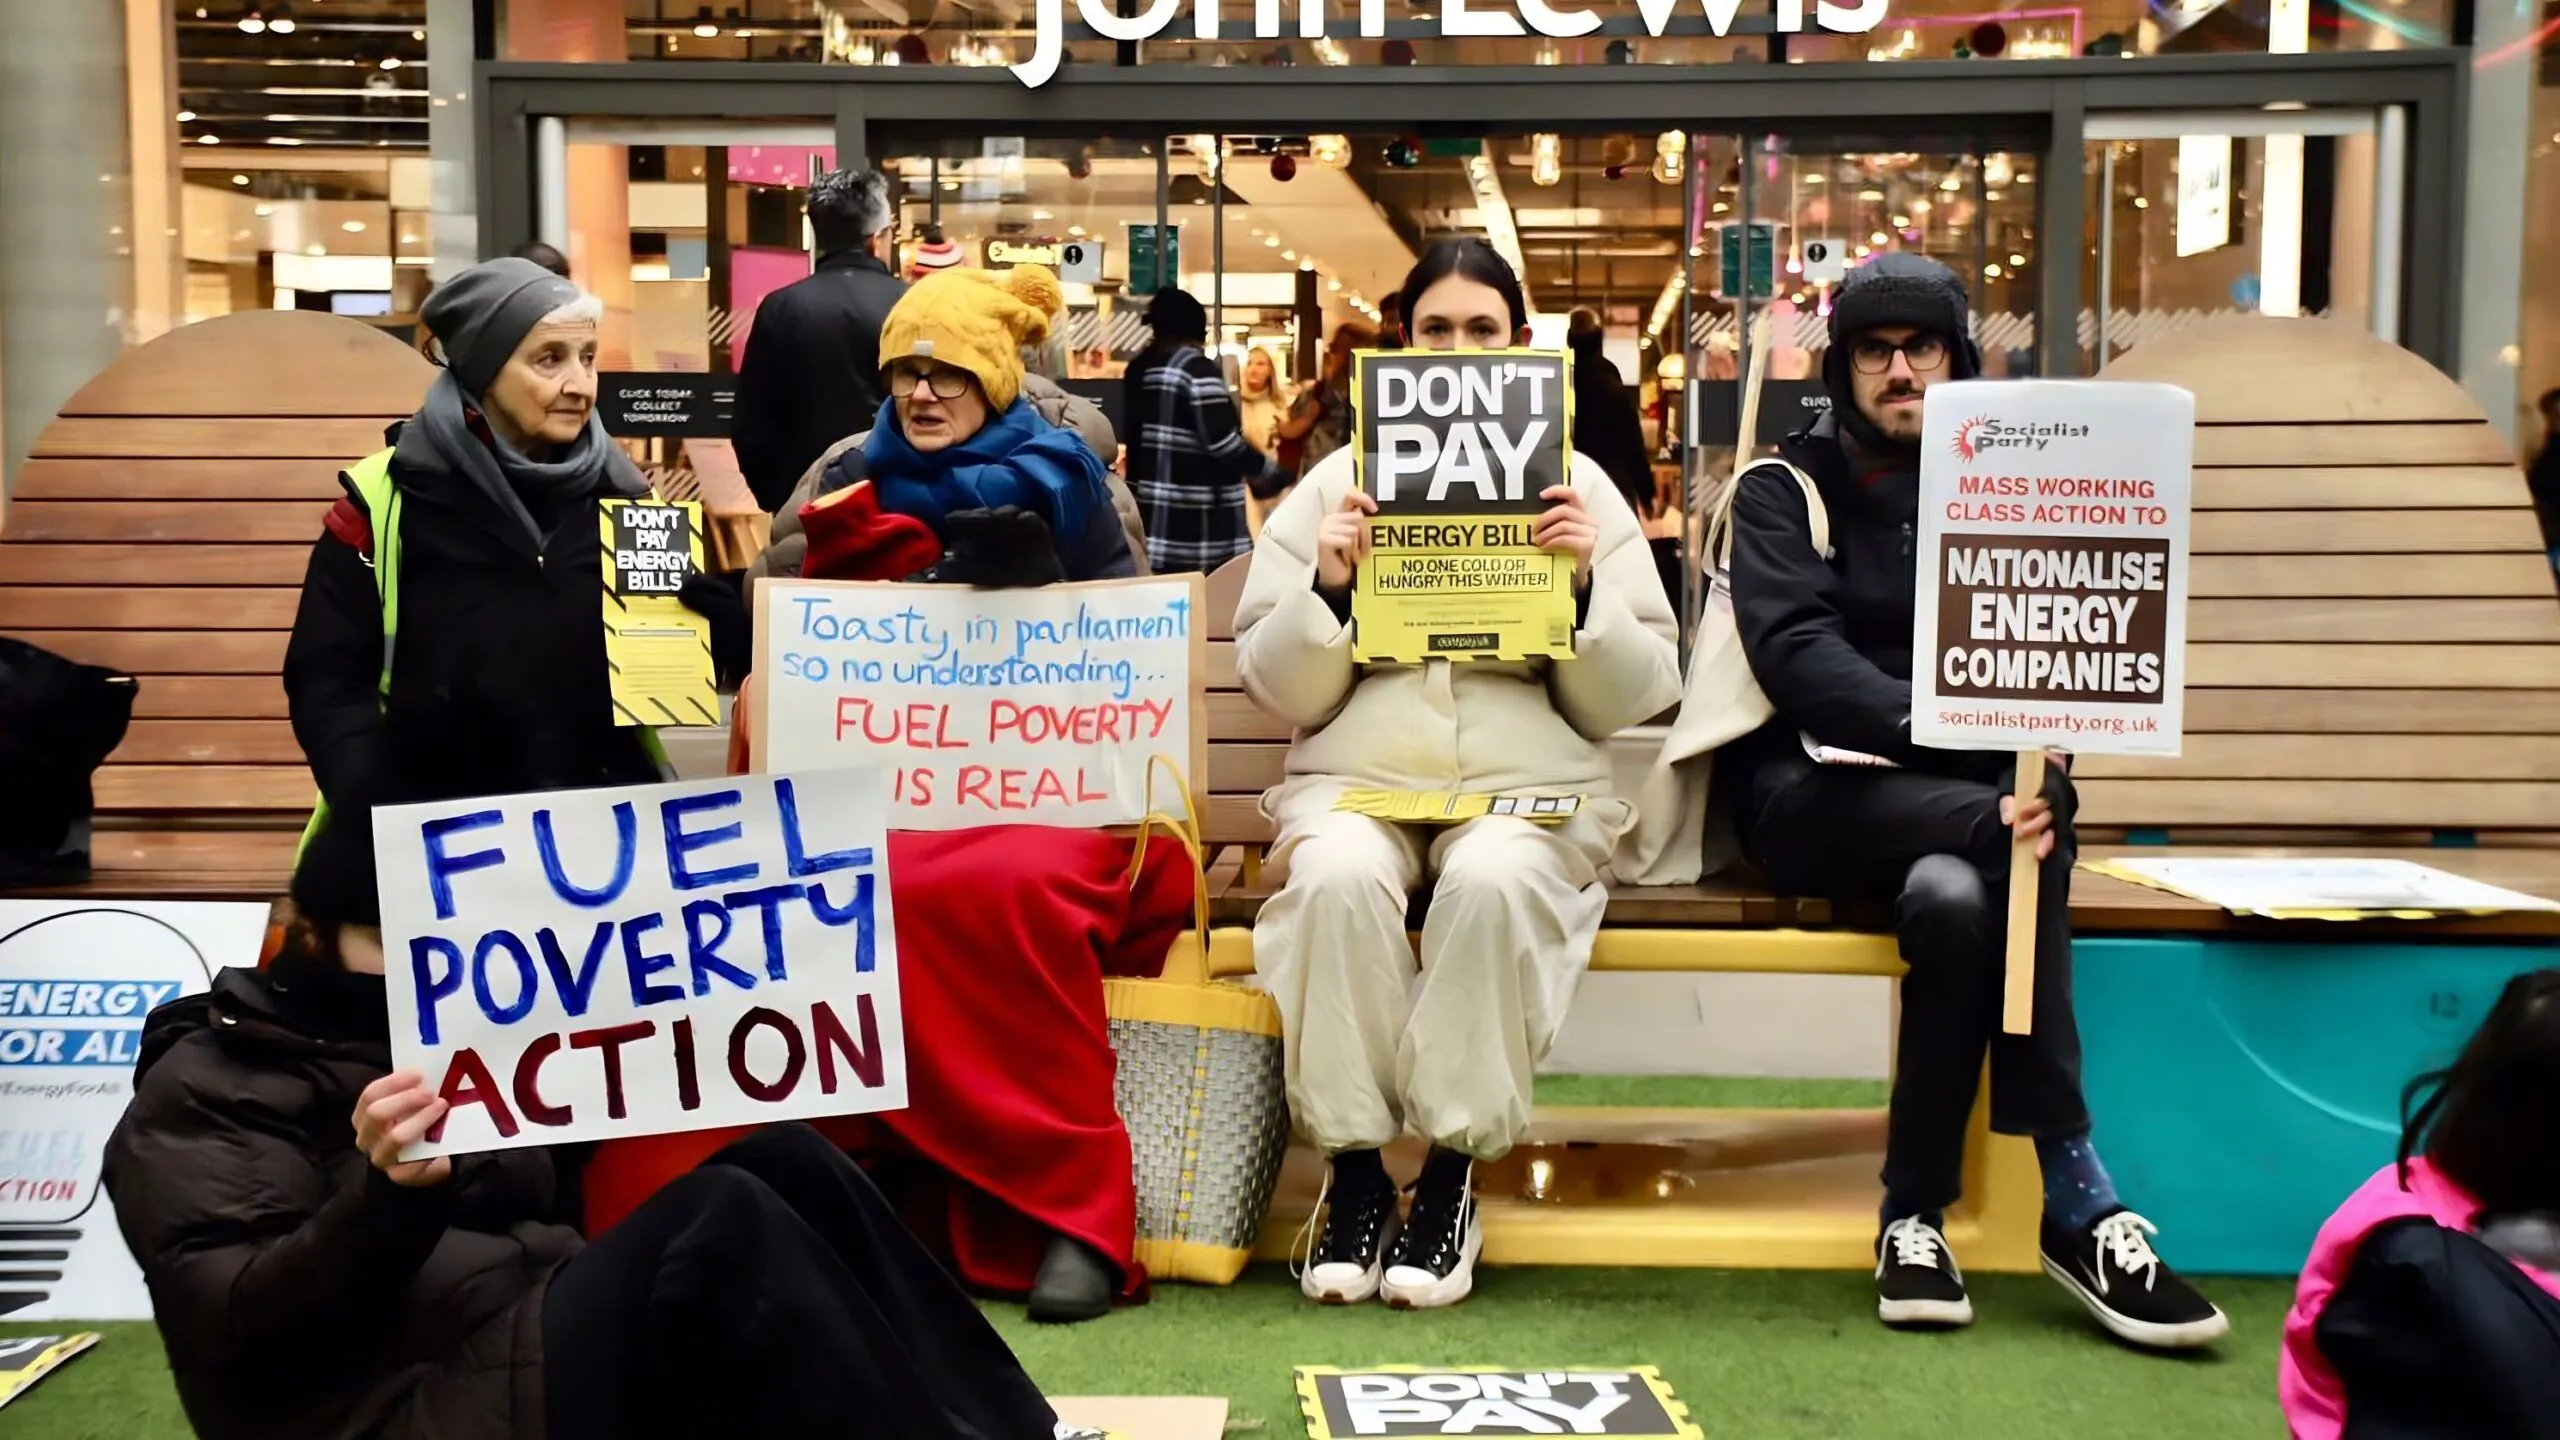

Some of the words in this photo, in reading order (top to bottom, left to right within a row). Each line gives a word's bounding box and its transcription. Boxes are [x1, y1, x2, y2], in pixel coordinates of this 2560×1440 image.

[1377, 363, 1555, 417] DON'T
[1983, 419, 2090, 437] Socialist
[1377, 421, 1549, 501] PAY
[1959, 476, 2029, 495] MASS
[2036, 478, 2155, 498] WORKING
[1946, 502, 2025, 522] CLASS
[2032, 504, 2125, 524] ACTION
[2132, 506, 2167, 525] TO
[636, 530, 670, 550] PAY
[1371, 524, 1478, 547] ENERGY
[616, 550, 690, 570] ENERGY
[1401, 559, 1423, 573] NO
[1427, 559, 1459, 573] ONE
[1462, 558, 1501, 572] COLD
[1504, 558, 1526, 572] OR
[1948, 548, 2165, 590] NATIONALISE
[628, 571, 682, 591] BILLS
[1379, 573, 1443, 589] HUNGRY
[1449, 573, 1482, 587] THIS
[1485, 572, 1548, 587] WINTER
[792, 598, 948, 660] Toasty
[966, 615, 997, 644] in
[1016, 599, 1189, 653] parliament
[1970, 592, 2139, 645] ENERGY
[783, 653, 828, 681] so
[843, 660, 882, 682] no
[894, 651, 1166, 699] understanding...
[1943, 646, 2160, 694] COMPANIES
[835, 696, 968, 748] FUEL
[989, 698, 1172, 746] POVERTY
[1938, 711, 2158, 735] socialistparty.org.uk
[895, 767, 934, 806] IS
[957, 766, 1108, 810] REAL
[422, 778, 873, 920] FUEL
[410, 874, 874, 1045] POVERTY
[0, 984, 176, 1015] ENERGY
[425, 993, 884, 1142] ACTION
[1341, 1372, 1630, 1400] DON'T
[1346, 1395, 1631, 1434] PAY
